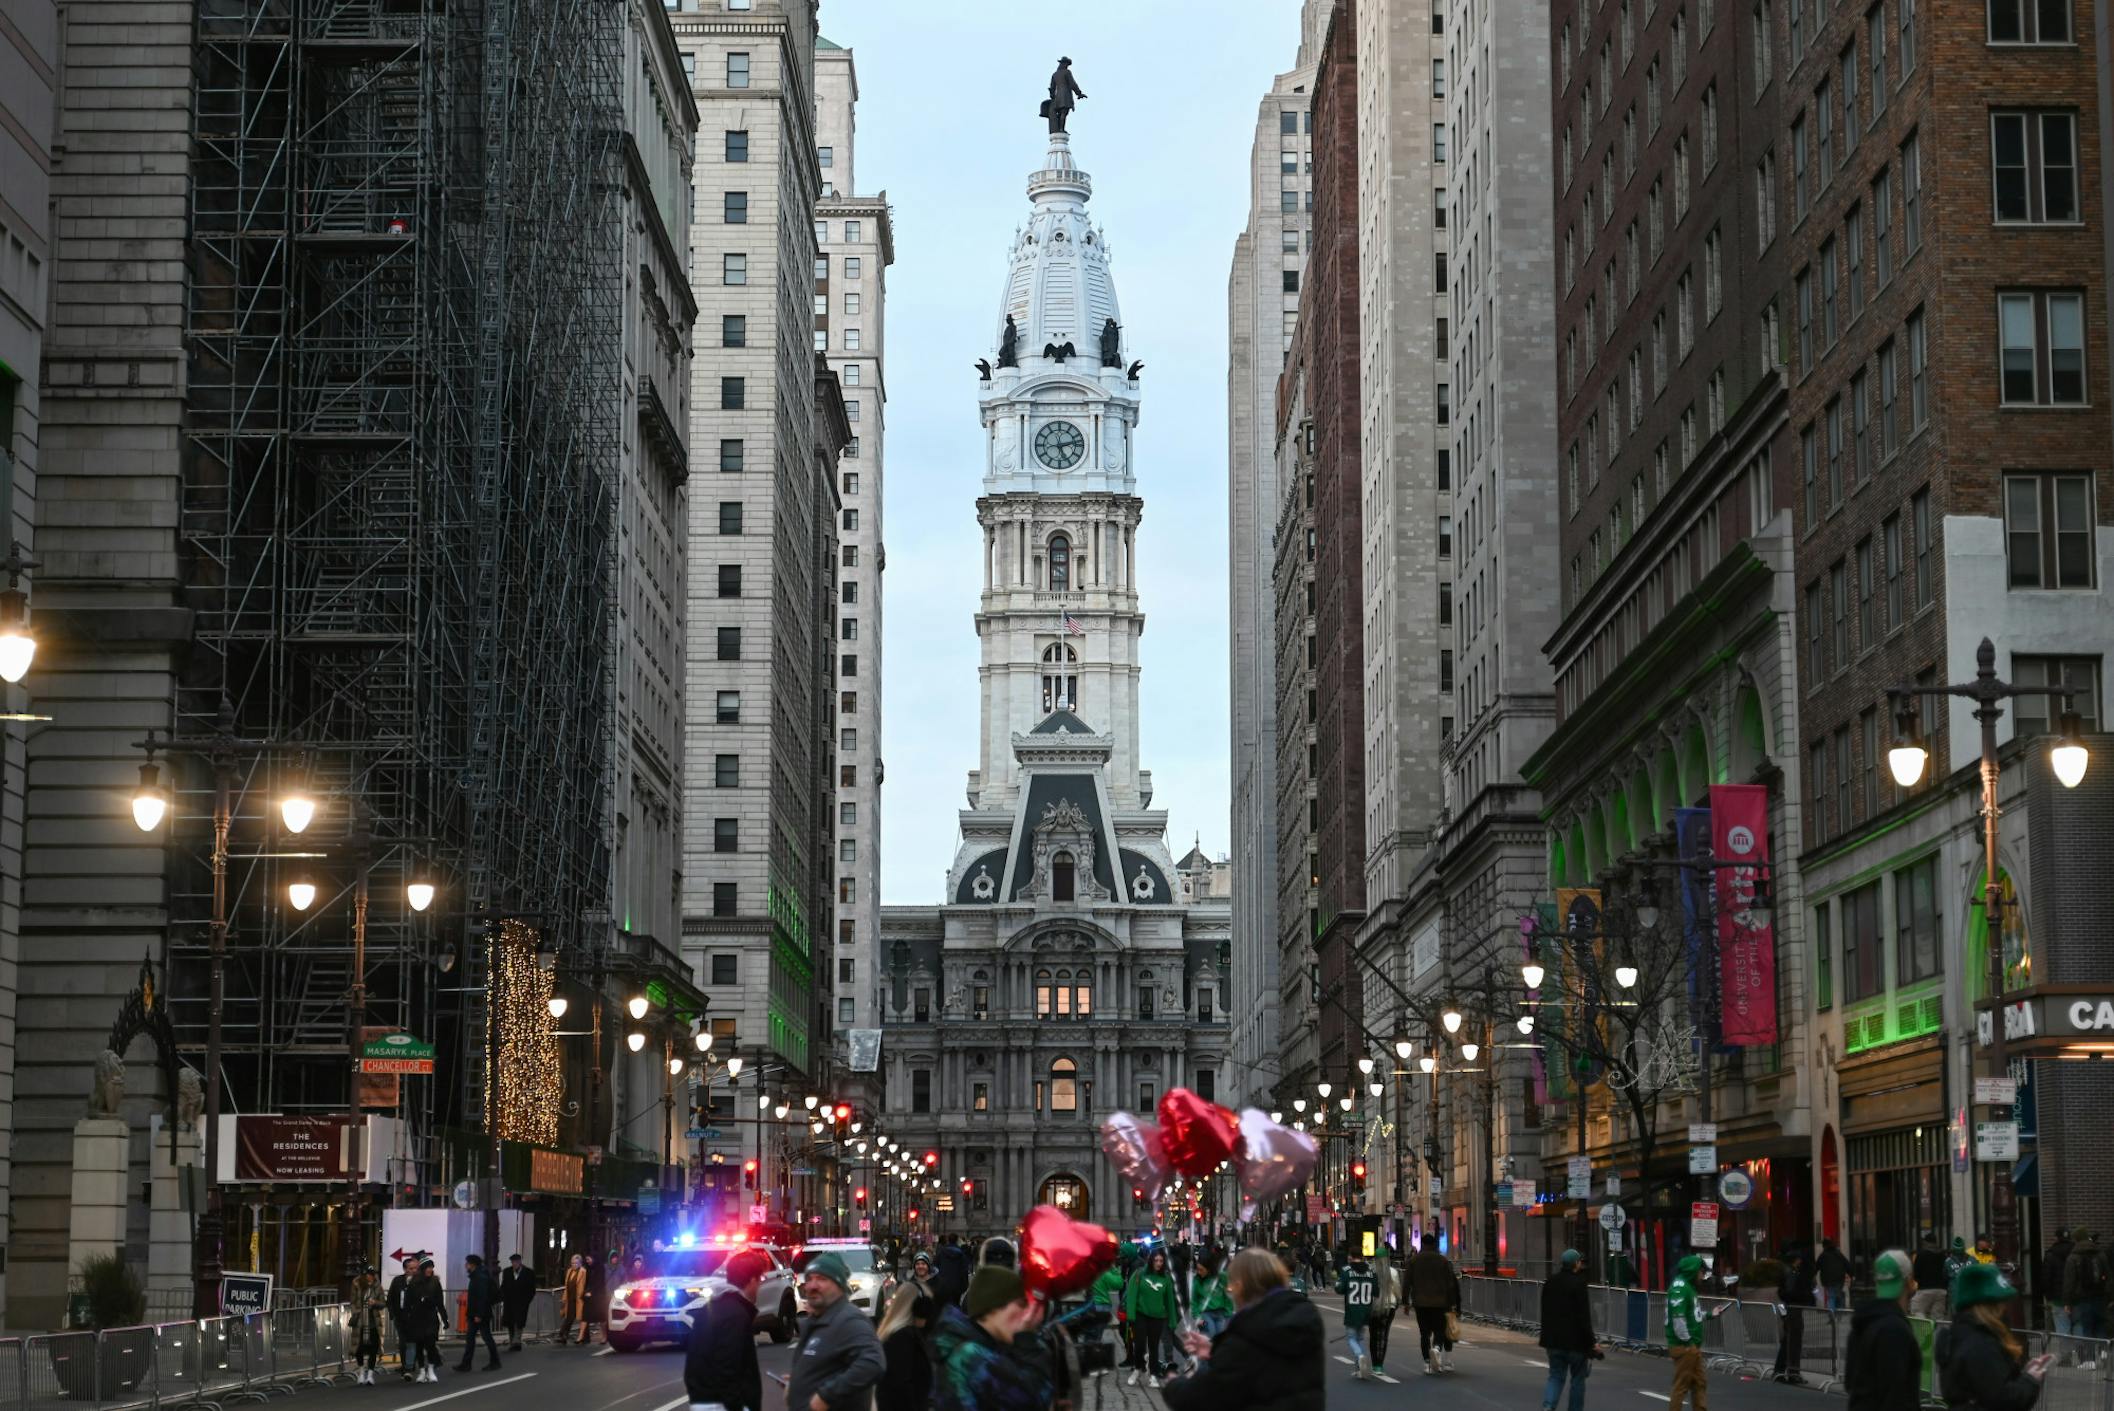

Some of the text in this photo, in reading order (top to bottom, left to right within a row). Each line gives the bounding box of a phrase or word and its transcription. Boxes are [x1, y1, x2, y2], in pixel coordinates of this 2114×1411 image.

[1749, 936, 1761, 987] OF THE
[367, 1047, 407, 1056] MASARYK
[367, 1061, 420, 1073] CHANCELLOR
[273, 1142, 329, 1150] RESIDENCES
[230, 1290, 259, 1301] PUBLIC
[1349, 1281, 1372, 1304] 20
